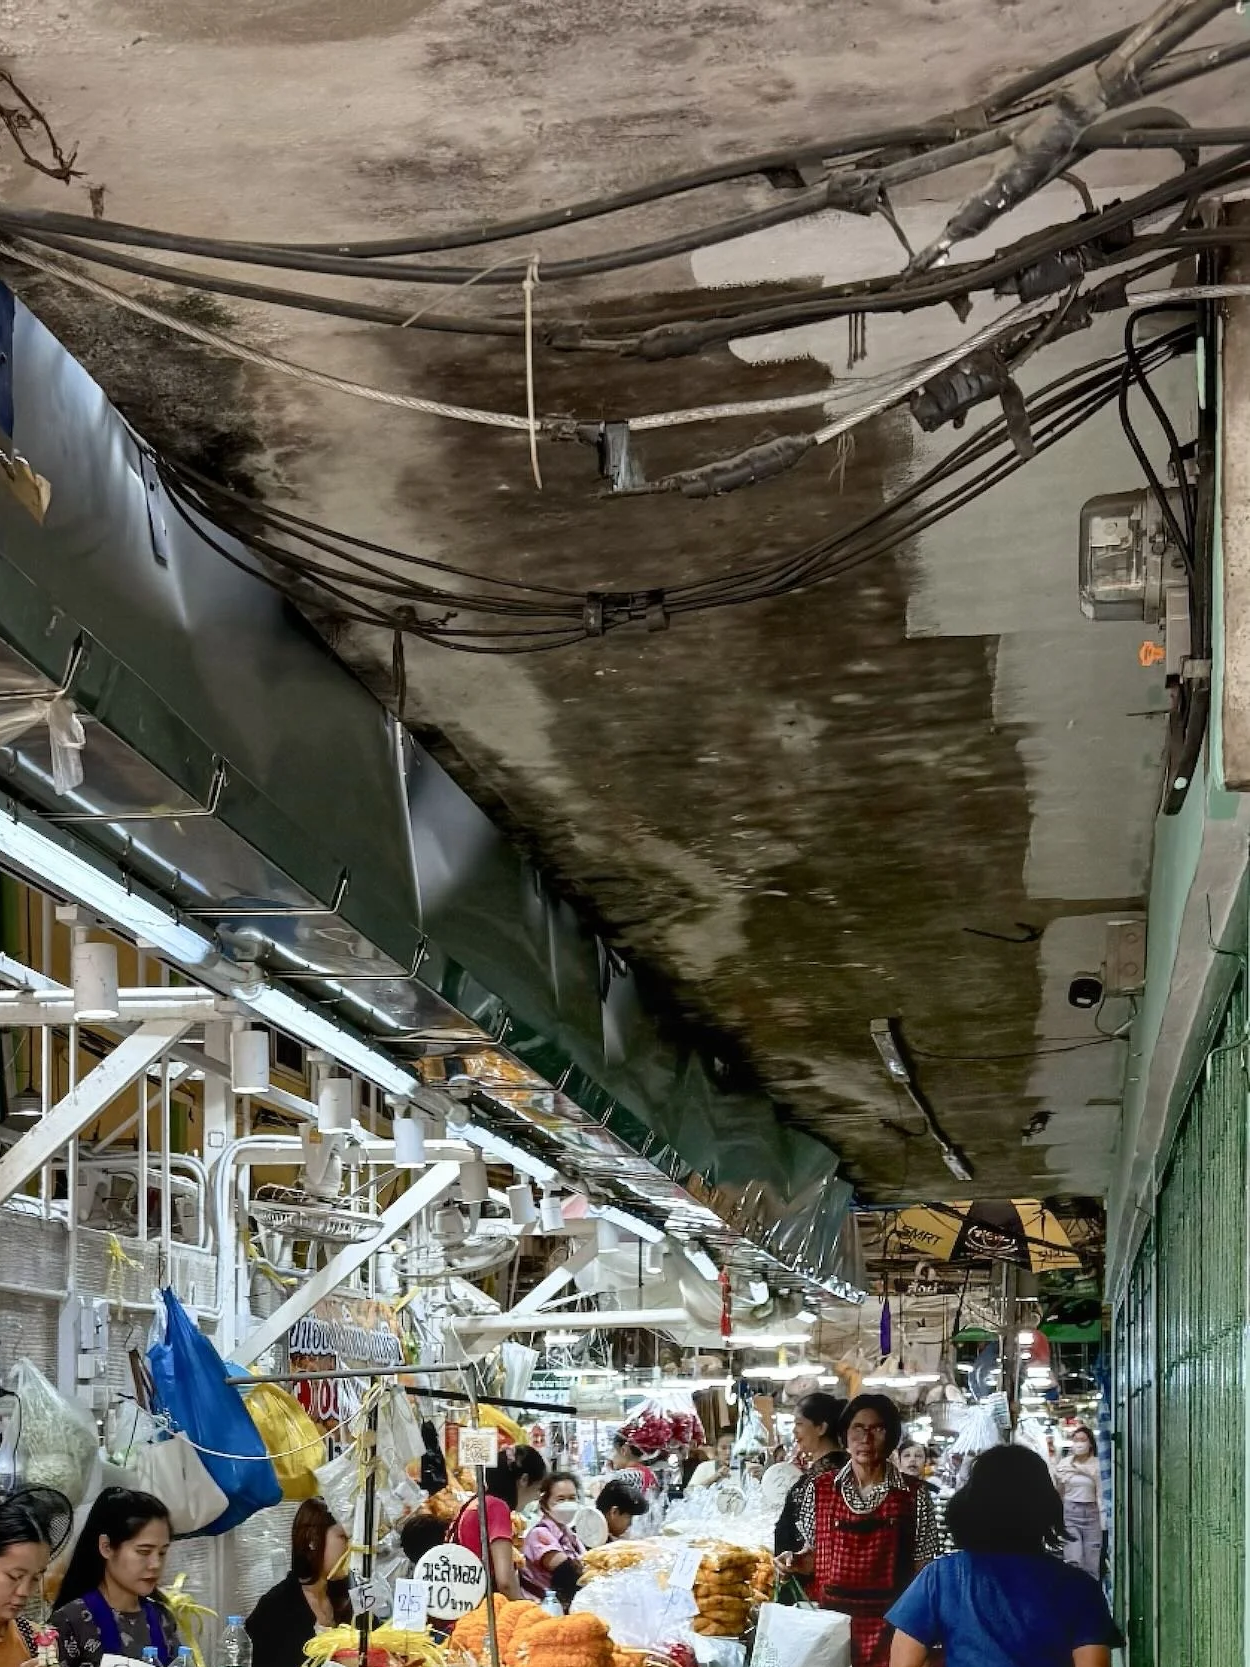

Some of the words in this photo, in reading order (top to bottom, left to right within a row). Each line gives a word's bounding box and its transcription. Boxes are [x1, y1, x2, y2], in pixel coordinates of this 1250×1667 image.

[422, 1555, 483, 1585] มะลิหอม
[427, 1585, 450, 1610] 10
